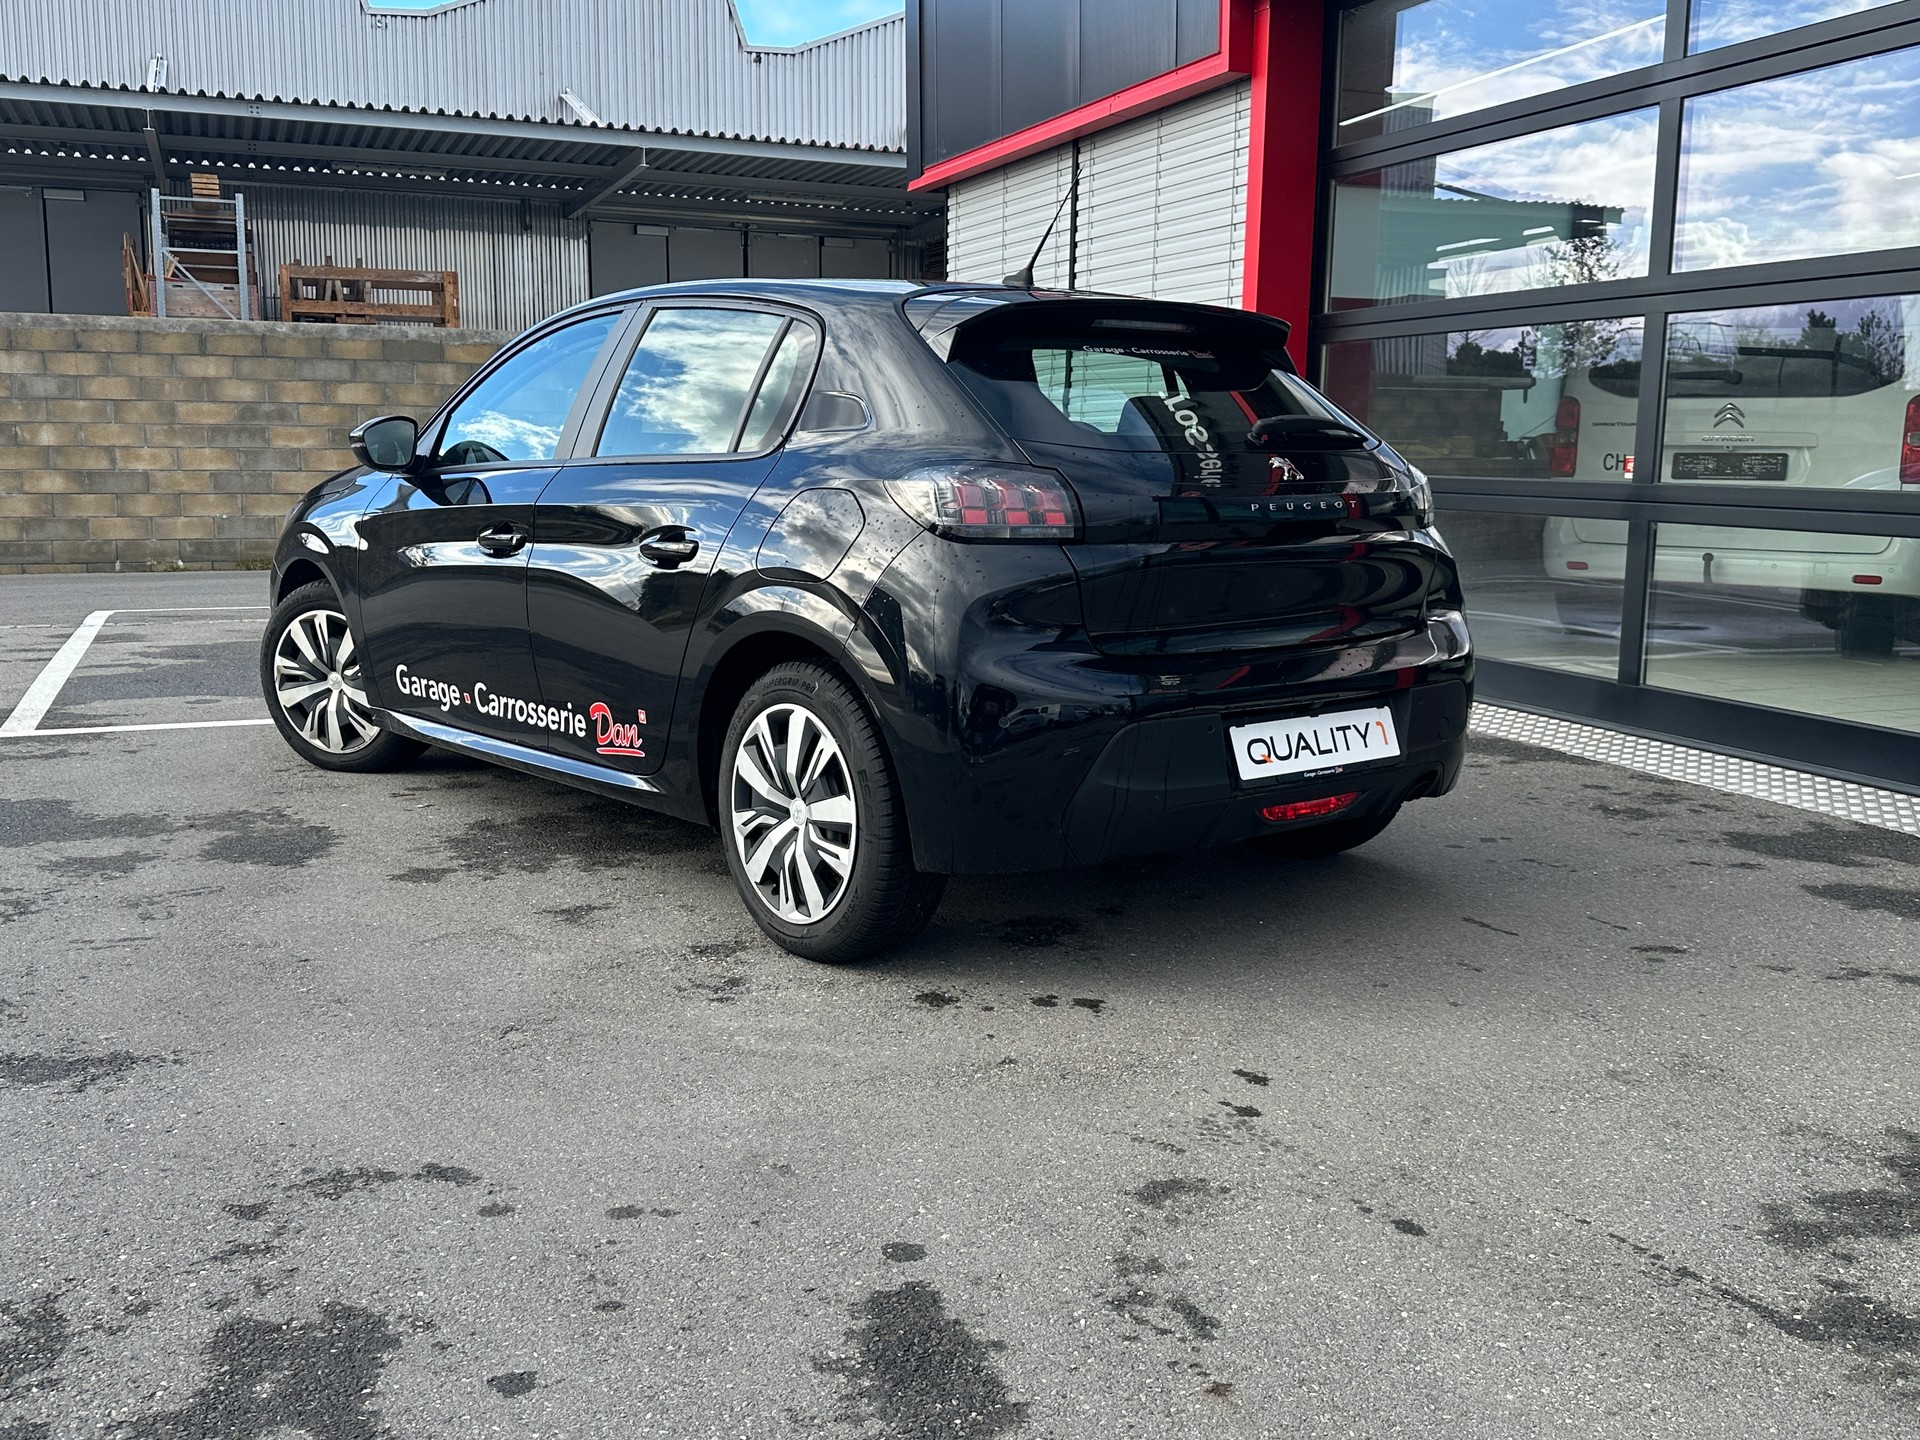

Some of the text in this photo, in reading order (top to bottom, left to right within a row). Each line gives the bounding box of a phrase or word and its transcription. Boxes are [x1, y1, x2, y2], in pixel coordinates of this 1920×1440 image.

[1083, 346, 1125, 355] Garage
[1131, 347, 1189, 357] Carrosserie
[1603, 453, 1626, 471] CH
[1251, 501, 1356, 511] PEUGEOT
[396, 664, 643, 748] Garage Carrosserie Dan
[1247, 722, 1370, 765] QUALITY
